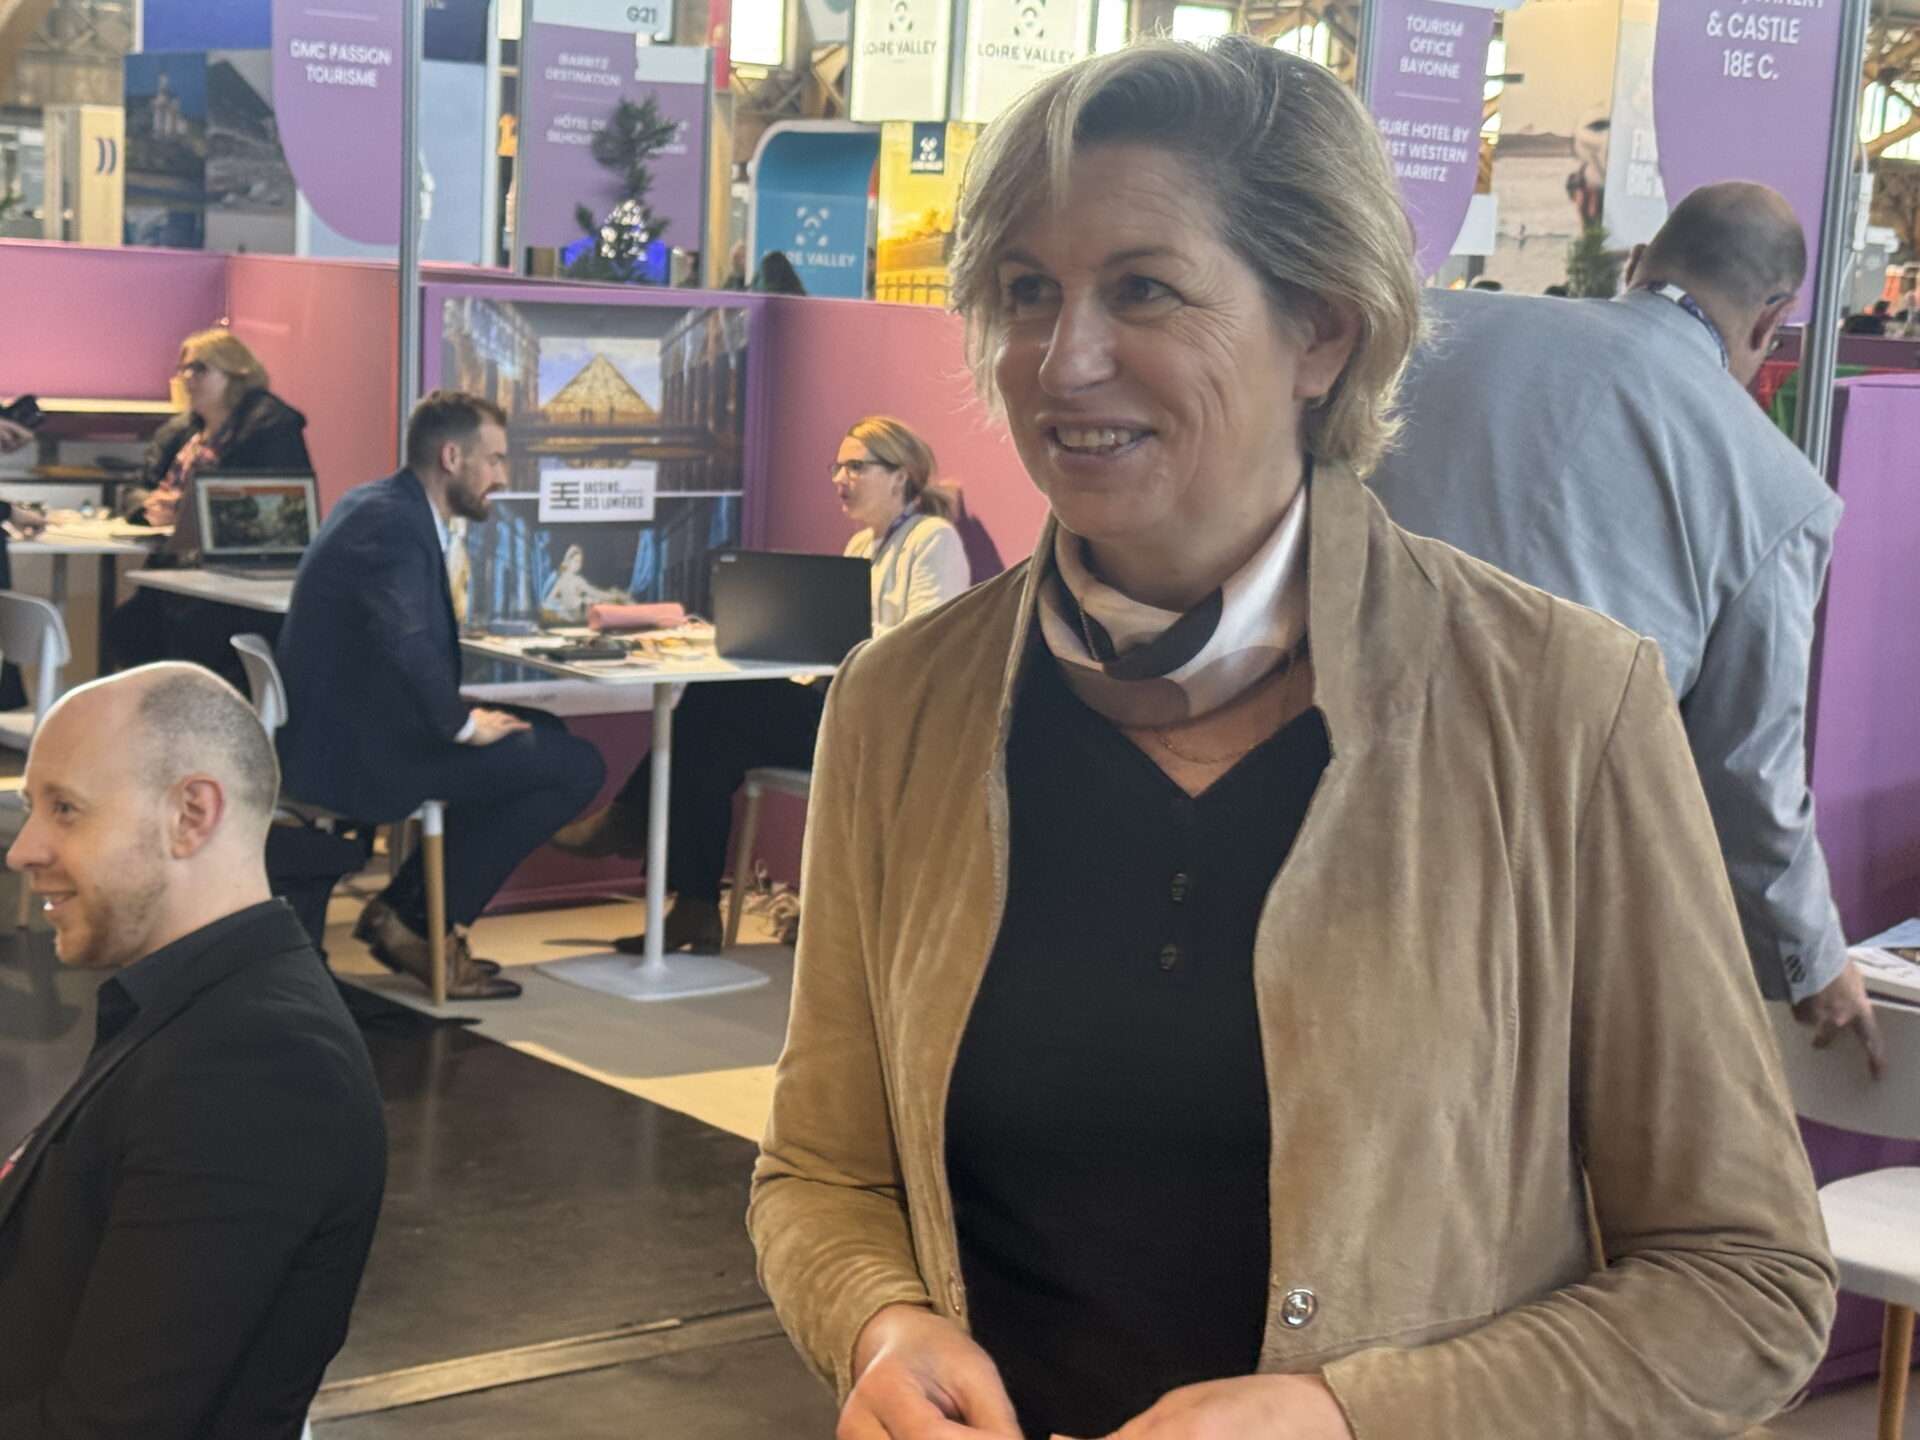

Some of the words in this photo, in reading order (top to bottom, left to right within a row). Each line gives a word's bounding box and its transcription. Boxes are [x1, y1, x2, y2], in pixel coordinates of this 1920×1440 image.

[626, 6, 656, 24] G21
[1405, 14, 1464, 37] TOURISM
[1706, 10, 1723, 37] &
[1727, 12, 1801, 44] CASTLE
[289, 38, 326, 60] DMC
[328, 42, 393, 66] PASSION
[896, 39, 937, 56] VALLEY
[977, 43, 1020, 60] LOIRE
[1023, 46, 1075, 64] VALLEY
[1409, 37, 1454, 58] OFFICE
[304, 63, 377, 88] TOURISME
[1399, 56, 1460, 80] BAYONNE
[1723, 50, 1754, 78] 18E
[1757, 54, 1780, 80] C.
[1411, 122, 1449, 142] HOTEL
[1452, 126, 1470, 144] BY
[1408, 143, 1467, 163] WESTERN
[807, 251, 855, 268] VALLEY
